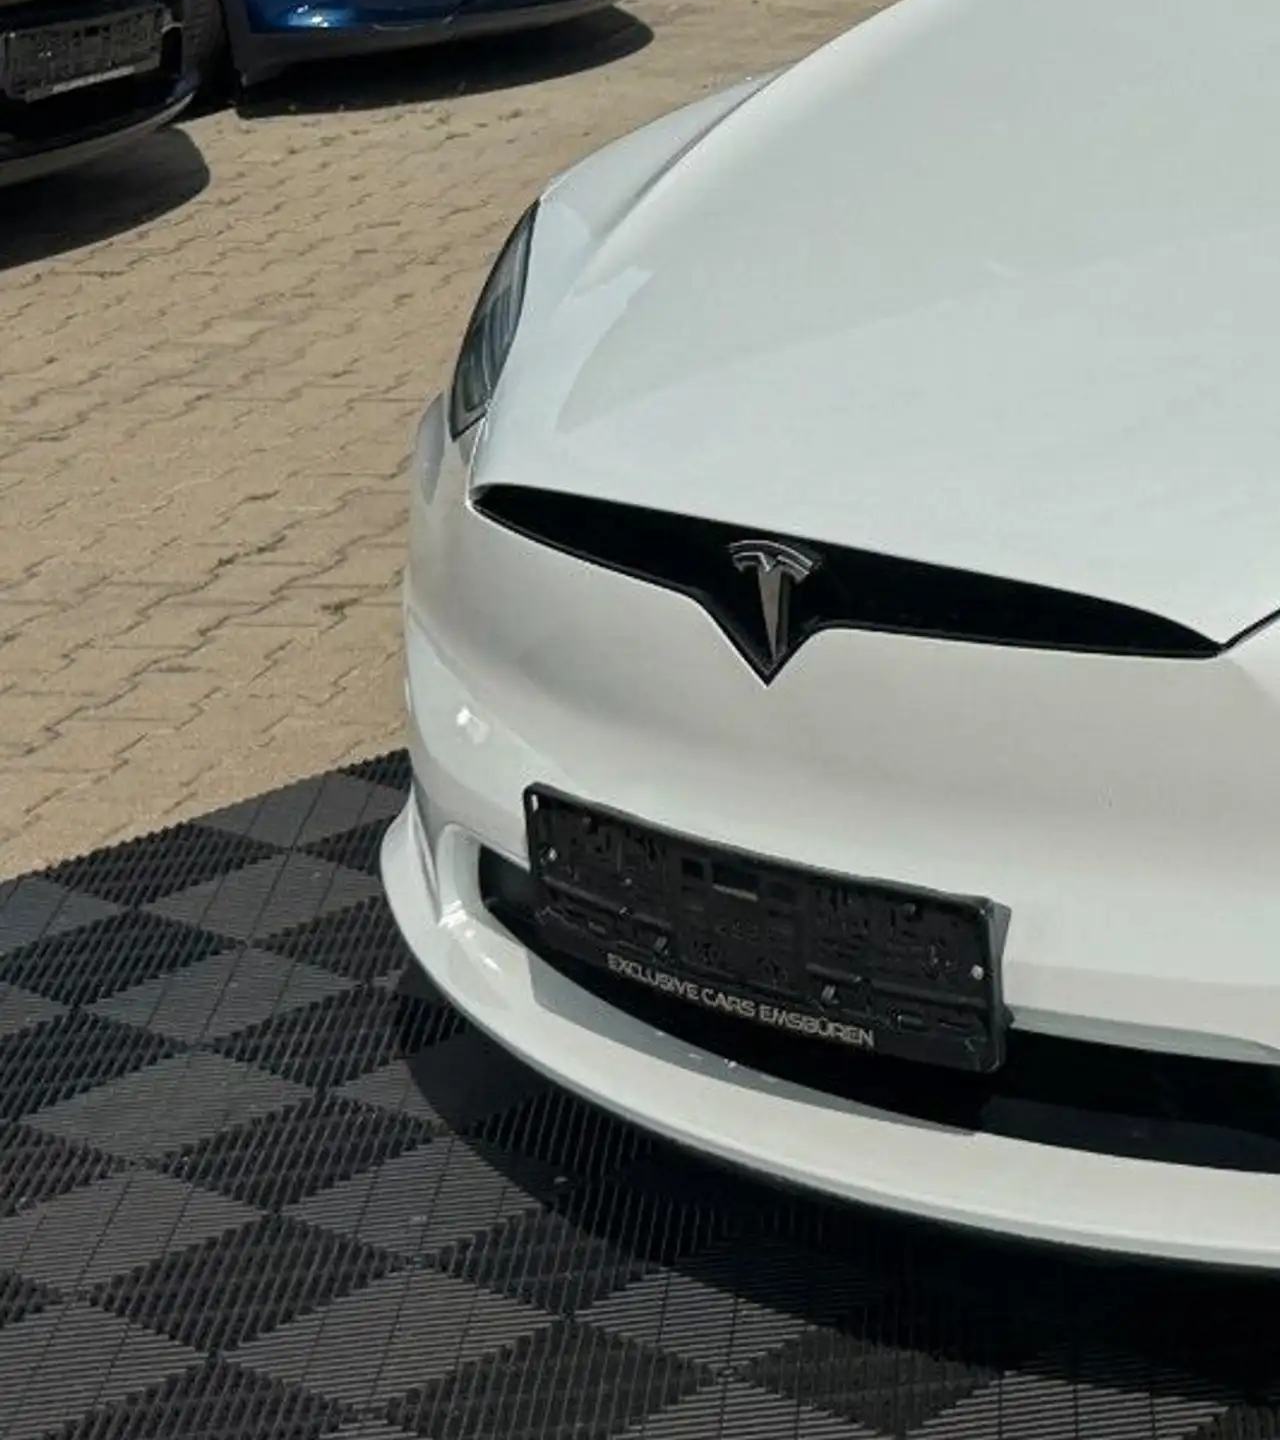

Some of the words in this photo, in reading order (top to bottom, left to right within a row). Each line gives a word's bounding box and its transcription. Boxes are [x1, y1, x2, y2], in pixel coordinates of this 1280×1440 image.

[606, 951, 700, 1001] EXCLUSIVE
[701, 987, 757, 1017] CARS
[759, 1005, 875, 1048] EMSBÜREN
